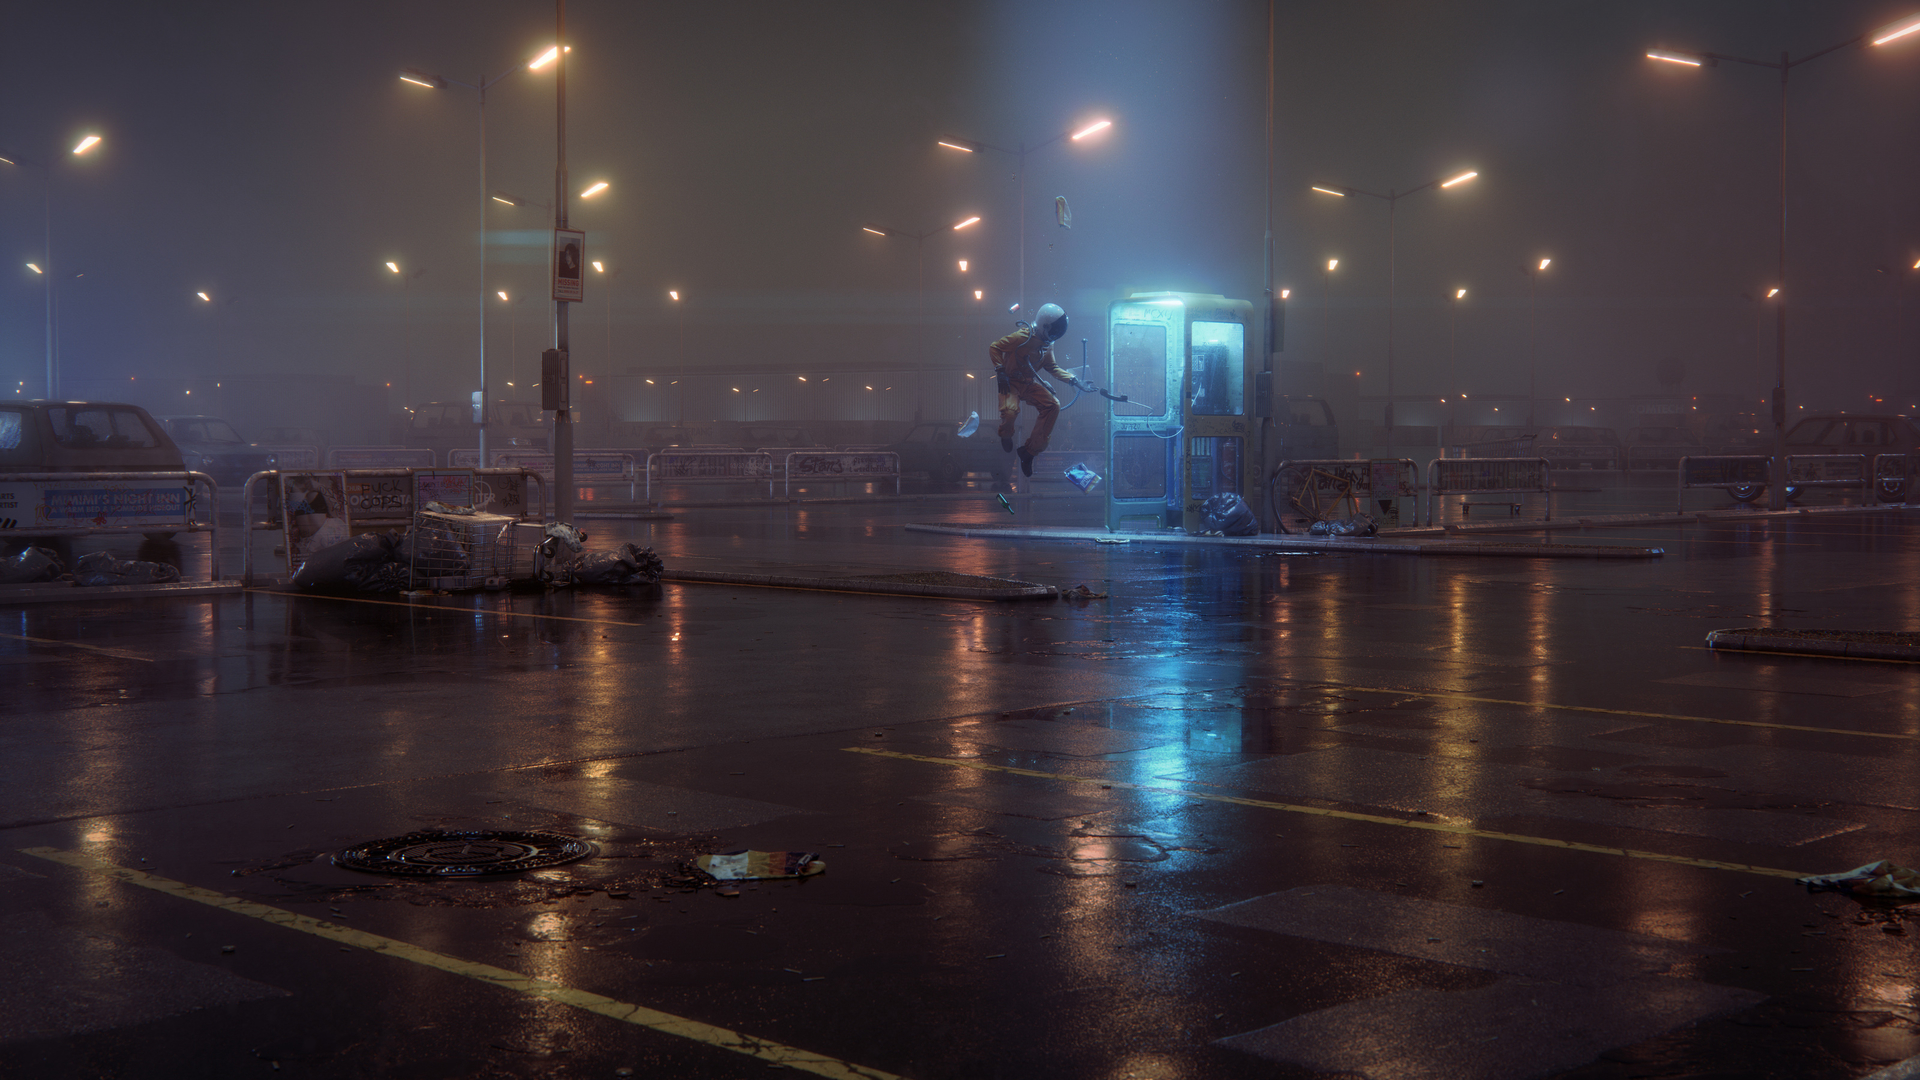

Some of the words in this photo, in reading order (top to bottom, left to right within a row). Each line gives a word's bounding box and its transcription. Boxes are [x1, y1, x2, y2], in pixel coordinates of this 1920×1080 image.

[557, 278, 579, 287] MISSING
[51, 494, 110, 506] MIMIMI'S
[114, 493, 154, 504] NIGHT
[157, 493, 181, 503] INN
[361, 495, 403, 510] COPS
